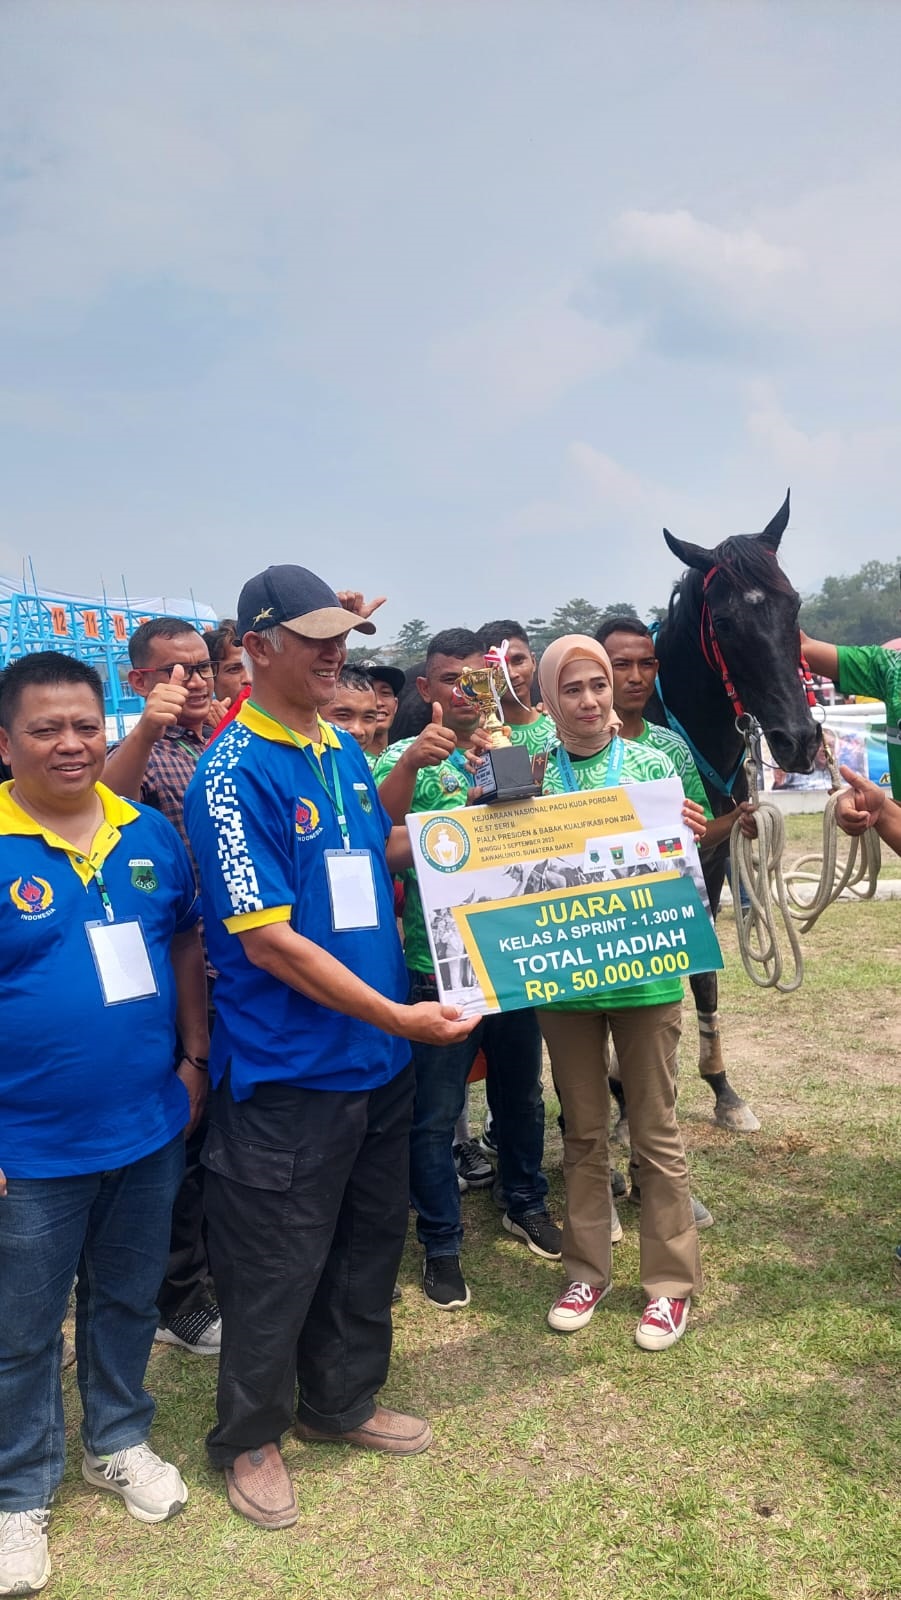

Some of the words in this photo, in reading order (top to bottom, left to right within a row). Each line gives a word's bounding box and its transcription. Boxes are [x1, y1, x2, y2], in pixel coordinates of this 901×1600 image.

[54, 611, 66, 631] 12
[85, 614, 97, 633] 11
[115, 617, 125, 636] 10
[471, 811, 513, 822] KEJUARAAN
[514, 806, 548, 817] NASIONAL
[549, 803, 568, 811] PACU
[569, 799, 588, 808] KUDA
[588, 795, 618, 805] PORDASI
[476, 835, 497, 844] PIALA
[497, 830, 531, 841] PRESIDEN
[538, 825, 563, 834] BABAK
[563, 818, 604, 831] KUALIFIKASI
[604, 816, 619, 824] PON
[619, 814, 635, 822] 2024
[494, 822, 510, 830] SERI
[479, 845, 502, 853] MINGGU
[507, 839, 541, 849] SEPTEMBER
[522, 846, 554, 855] SUMATERA
[554, 842, 574, 851] BARAT
[20, 908, 57, 921] INDONESIA
[535, 893, 627, 927] JUARA
[630, 887, 654, 910] III
[499, 931, 553, 953] KELAS
[556, 929, 569, 942] A
[570, 917, 627, 939] SPRINT
[640, 908, 678, 926] 1.300
[681, 904, 695, 919] M
[512, 947, 593, 976] TOTAL
[596, 928, 687, 961] HADIAH
[524, 979, 566, 1003] Rp.
[571, 951, 690, 991] 50.000.000
